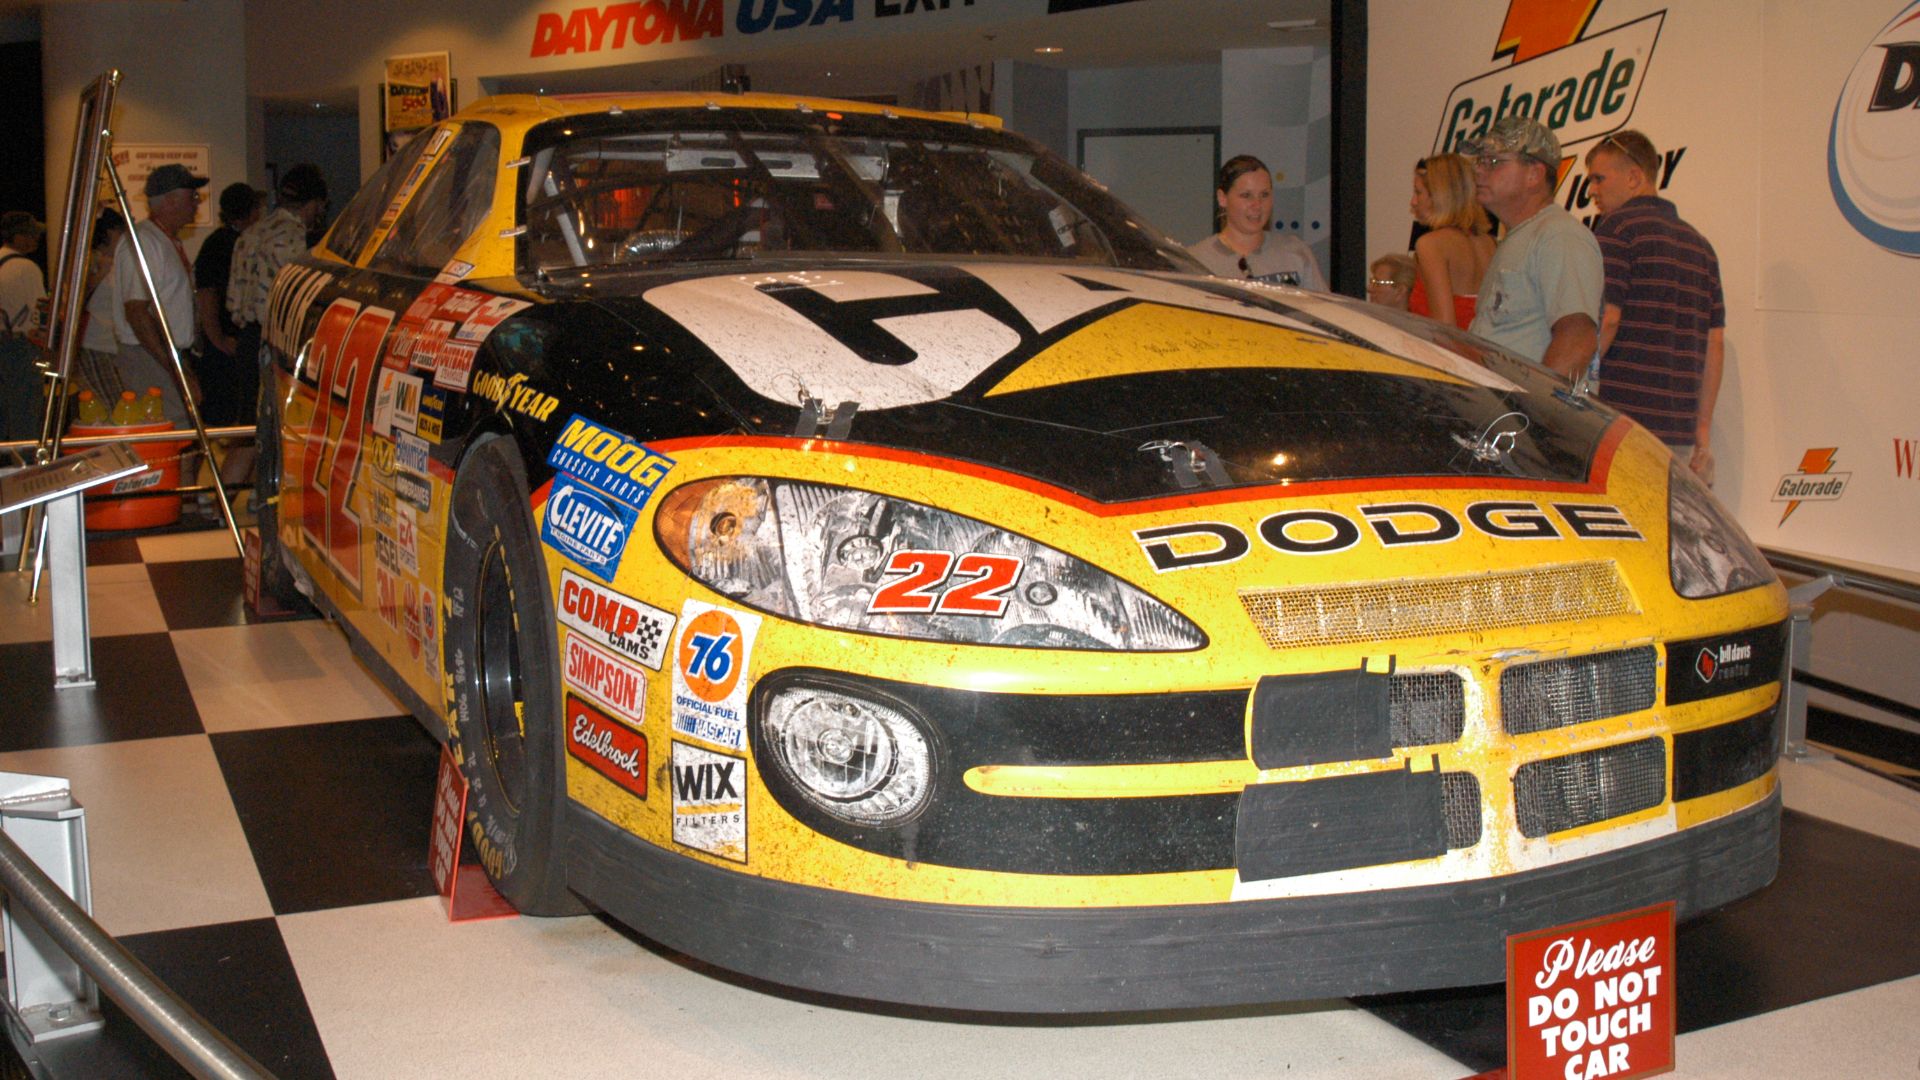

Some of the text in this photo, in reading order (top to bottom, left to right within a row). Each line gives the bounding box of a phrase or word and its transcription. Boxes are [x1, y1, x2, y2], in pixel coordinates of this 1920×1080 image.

[530, 0, 724, 58] DAYTONA
[472, 370, 559, 422] GOODYEAR
[551, 449, 645, 505] CHASSIS PARTS
[557, 418, 674, 487] MOOG
[1777, 477, 1843, 497] Gatorade
[550, 485, 624, 554] CLEVITE
[1132, 501, 1647, 574] DODGE
[551, 529, 607, 566] ENGINE PARTS
[562, 580, 640, 638] COMP
[866, 549, 1025, 619] 22
[608, 631, 650, 660] CAMS
[687, 634, 734, 682] 76
[1719, 643, 1751, 663] bill davis
[568, 642, 639, 711] SIMPSON
[676, 695, 740, 722] OFFICIAL FUEL
[693, 716, 742, 747] NASCAR
[572, 714, 641, 778] Edelbrock
[675, 761, 738, 801] WIX
[676, 814, 740, 826] FILTERS
[1535, 936, 1656, 990] Please
[1528, 965, 1662, 1027] DO NOT
[1541, 1002, 1652, 1057] TOUCH
[1564, 1042, 1631, 1080] CAR
